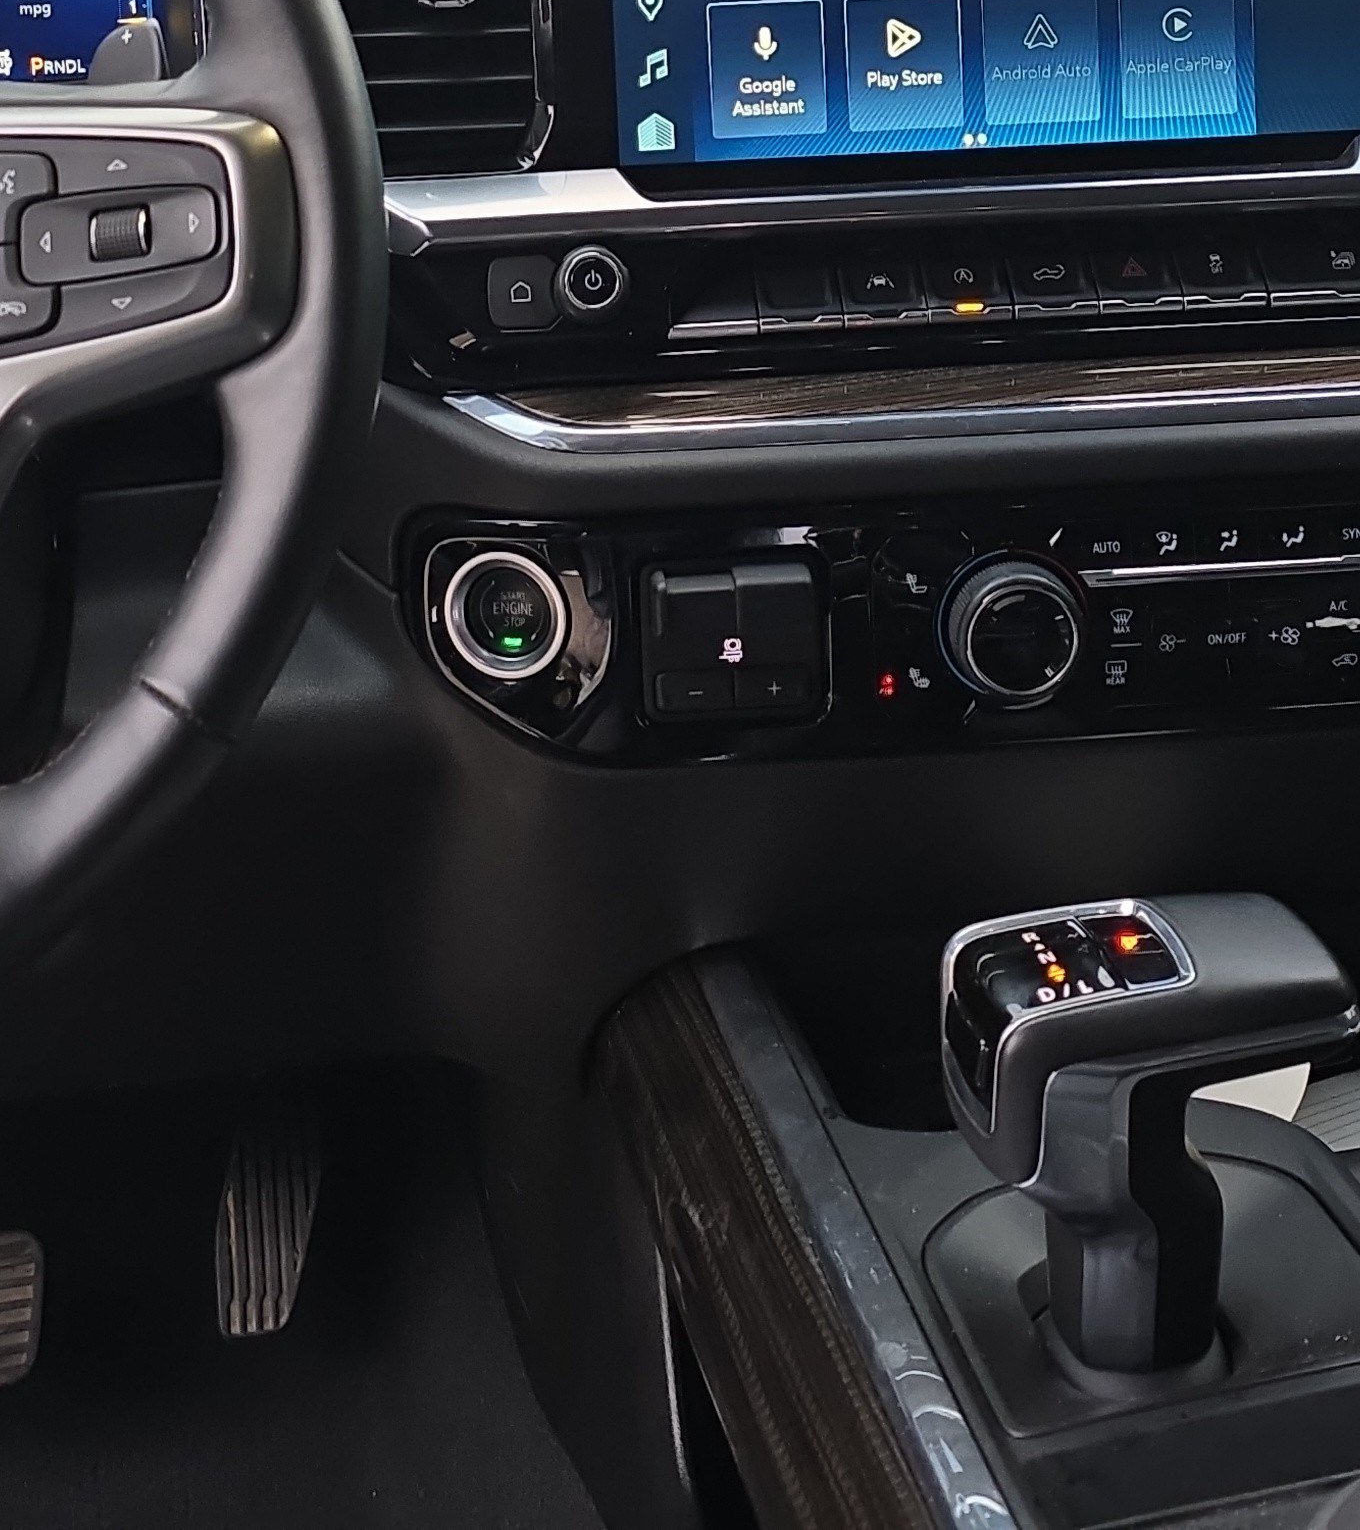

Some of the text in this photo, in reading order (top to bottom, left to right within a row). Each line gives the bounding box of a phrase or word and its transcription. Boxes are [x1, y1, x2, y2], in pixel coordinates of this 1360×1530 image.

[19, 3, 52, 18] mpg
[128, 0, 137, 15] 1
[30, 56, 87, 76] PRNDL
[991, 63, 1091, 82] Android Auto
[1125, 56, 1233, 77] Apple CarPlay
[739, 75, 796, 96] Google
[866, 69, 943, 90] Play Store
[732, 98, 805, 117] Assistant
[1092, 540, 1121, 553] AUTO
[501, 592, 525, 600] START
[493, 602, 533, 616] ENGINE
[1329, 600, 1348, 611] A/C
[504, 618, 525, 627] STOP
[1113, 624, 1131, 634] MAX
[1207, 632, 1247, 646] ON/OFF
[1105, 675, 1126, 685] REAR
[1037, 951, 1057, 965] N
